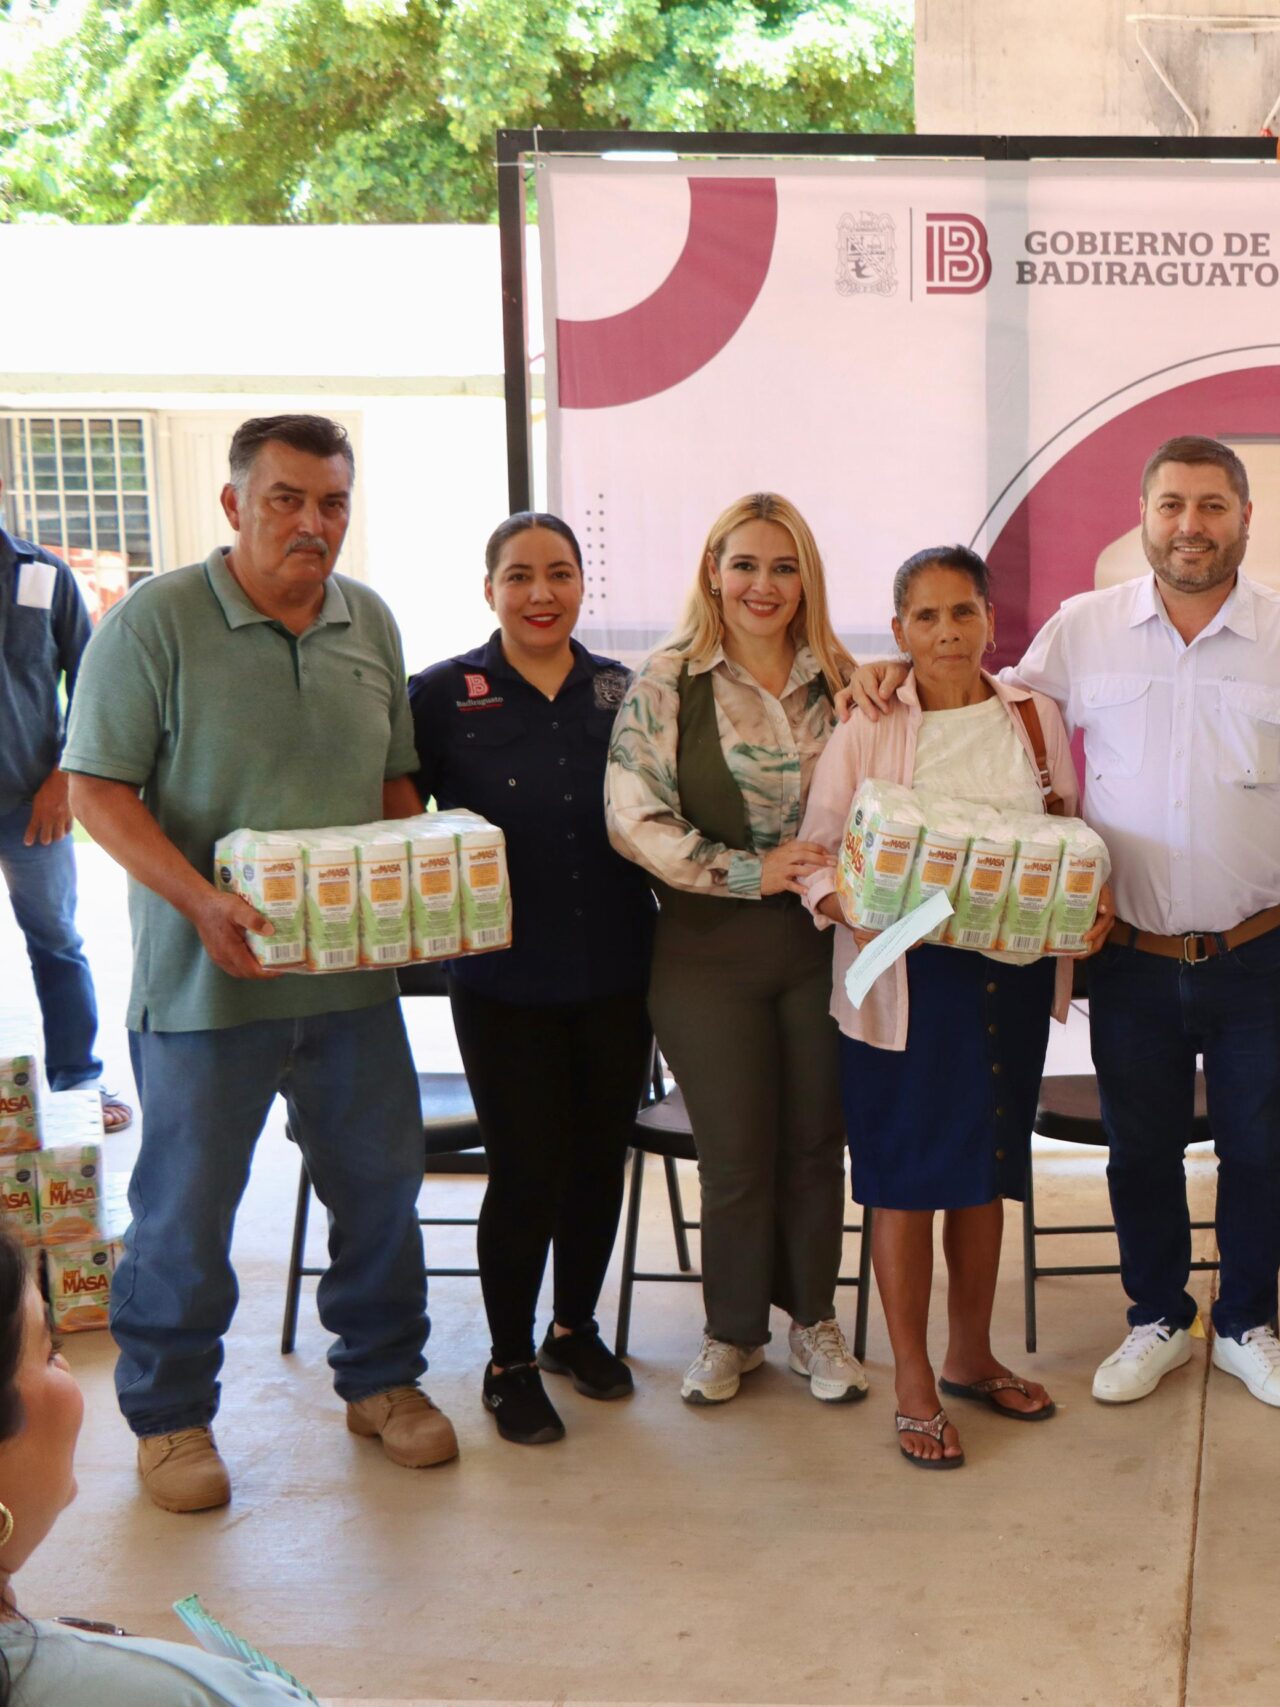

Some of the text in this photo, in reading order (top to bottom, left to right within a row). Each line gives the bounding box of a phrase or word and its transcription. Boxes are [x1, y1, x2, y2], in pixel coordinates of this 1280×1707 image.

[1024, 230, 1271, 257] GOBIERNO DE
[1015, 261, 1280, 288] BADIRAGUATO
[49, 1187, 96, 1206] MASA
[63, 1274, 109, 1294] MASA
